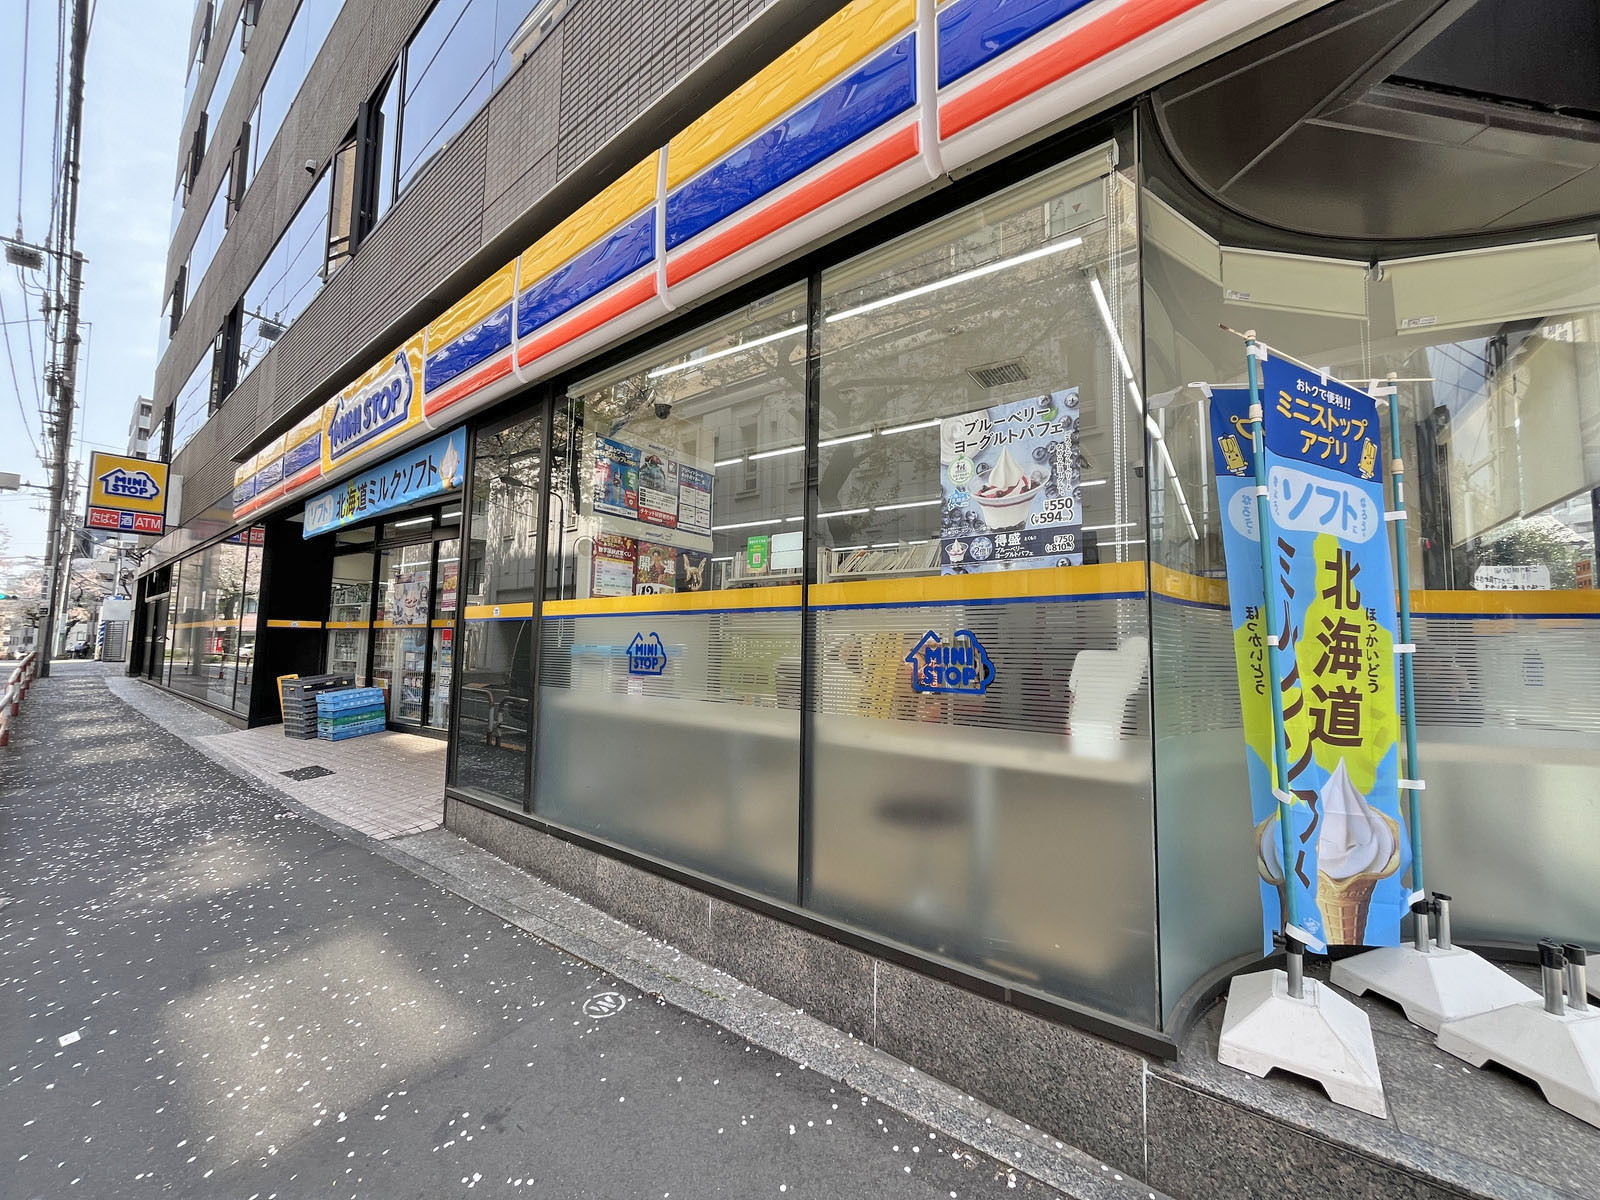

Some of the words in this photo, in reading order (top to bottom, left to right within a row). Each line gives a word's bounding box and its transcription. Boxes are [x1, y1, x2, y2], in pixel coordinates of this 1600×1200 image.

[333, 404, 362, 447] MINI
[363, 378, 402, 430] STOP
[964, 407, 1050, 435] ブルーベリー
[1276, 390, 1368, 441] ミニストップ
[954, 421, 1063, 454] ヨーグルトパフェ
[1300, 430, 1348, 464] アプリ
[111, 483, 149, 496] STOP
[114, 475, 148, 487] MINI
[336, 454, 438, 521] 北海道ミルクソフト
[1282, 477, 1358, 531] ソフト
[90, 511, 118, 525] たばこ
[120, 514, 133, 526] 酒
[135, 517, 161, 529] ATM
[994, 532, 1022, 547] 得盛
[635, 643, 658, 656] MINI
[924, 646, 974, 666] MINI
[1309, 548, 1364, 748] 北海道
[1365, 607, 1379, 694] ほっかいどう
[633, 656, 659, 670] STOP
[922, 665, 977, 687] STOP
